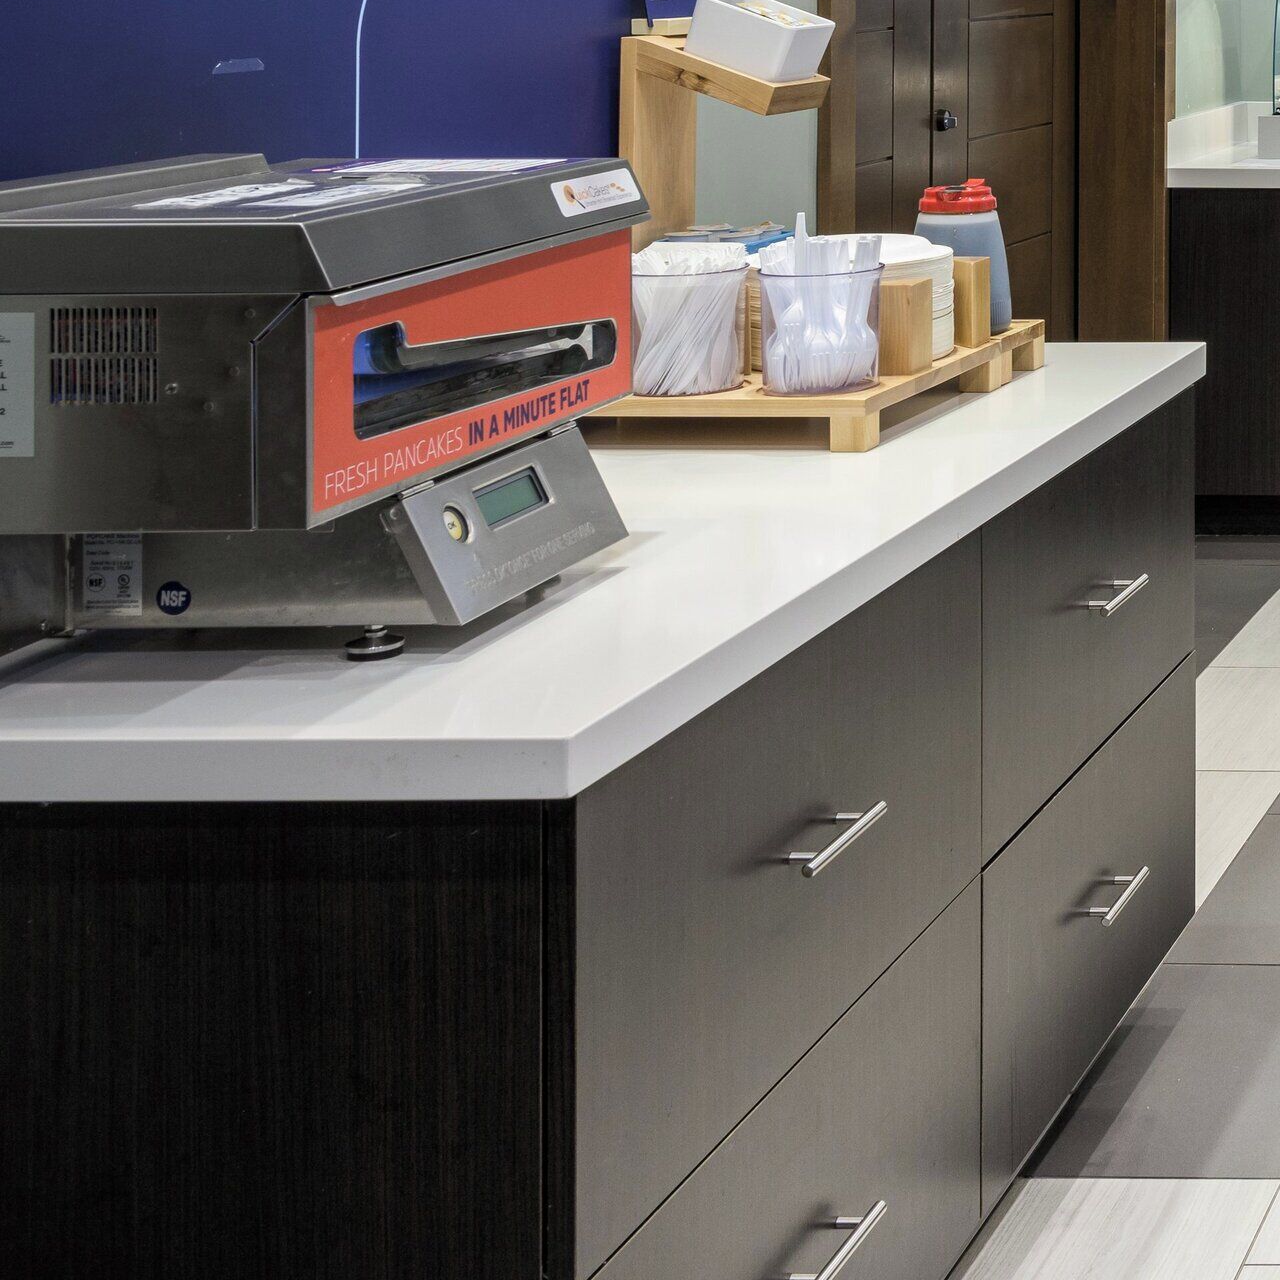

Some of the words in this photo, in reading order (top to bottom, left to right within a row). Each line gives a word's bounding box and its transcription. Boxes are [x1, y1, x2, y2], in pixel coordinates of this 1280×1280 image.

[325, 457, 378, 500] FRESH
[384, 426, 463, 478] PANCAKES
[468, 419, 484, 446] IN
[489, 414, 499, 439] A
[503, 392, 556, 433] MINUTE
[559, 379, 590, 410] FLAT
[160, 590, 187, 607] NSF
